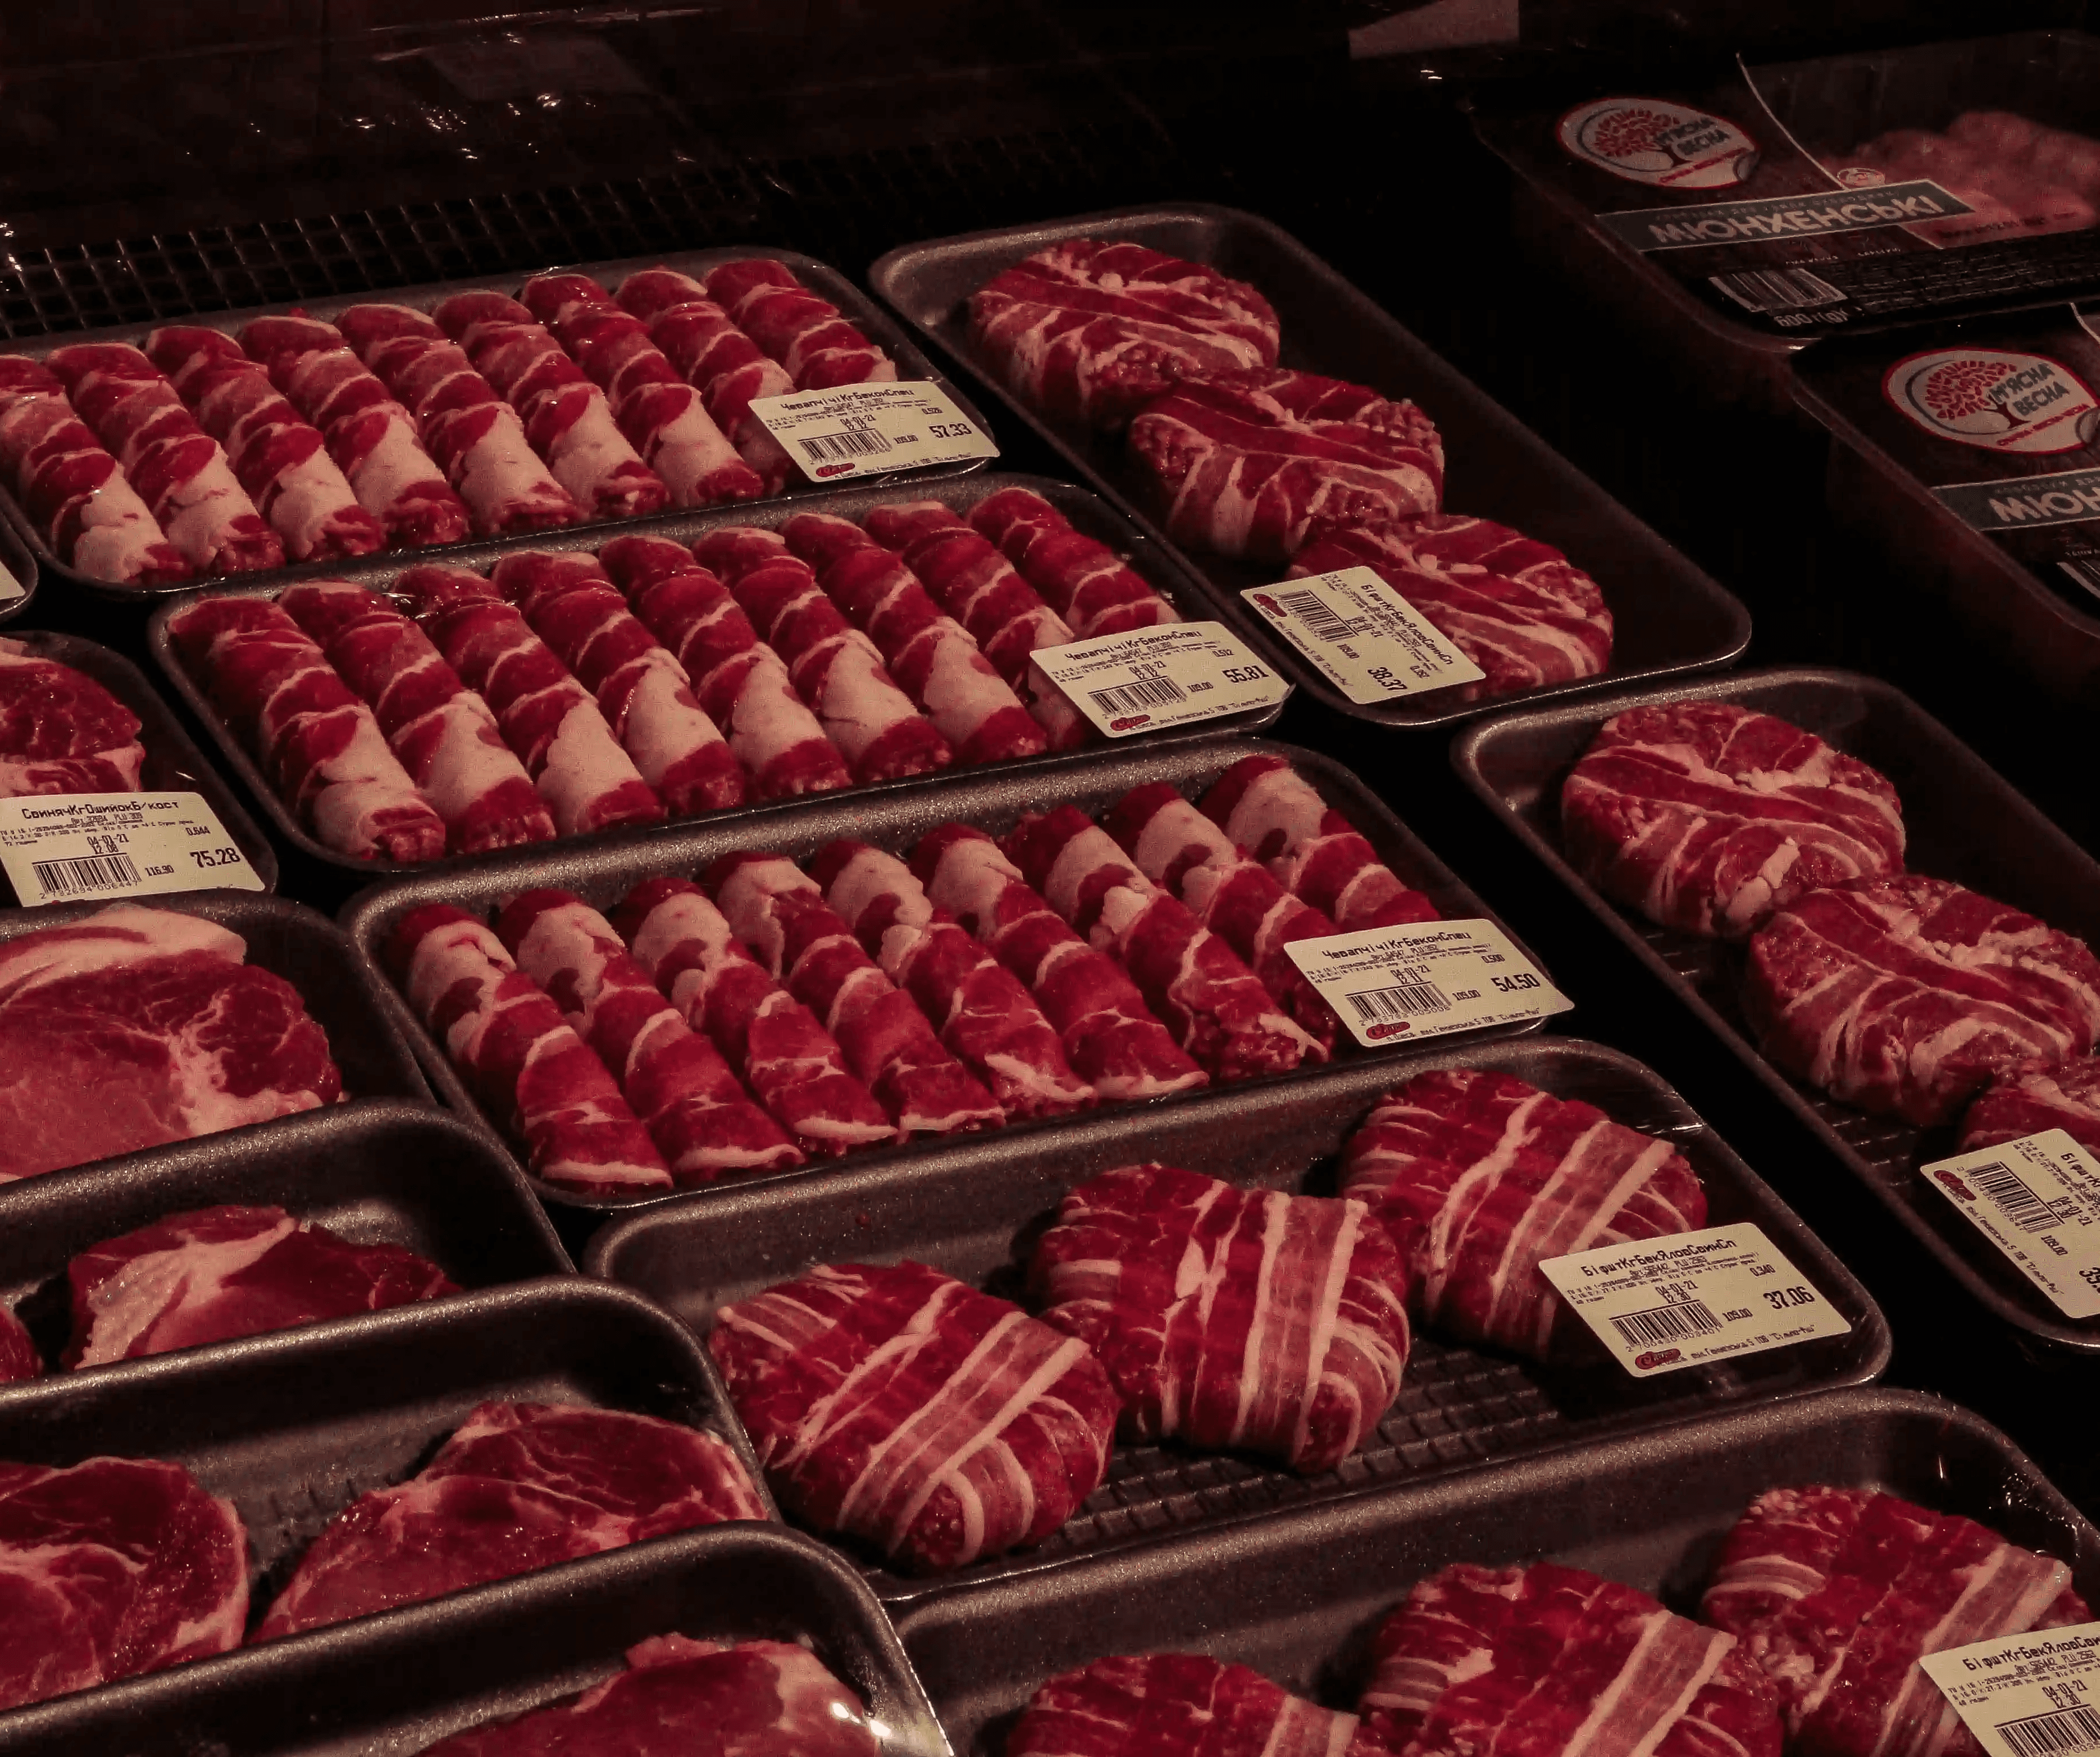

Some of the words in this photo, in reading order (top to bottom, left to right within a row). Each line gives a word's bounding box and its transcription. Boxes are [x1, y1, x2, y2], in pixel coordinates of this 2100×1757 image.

[1648, 194, 1945, 243] МЮНХЕНСЬКІ
[2013, 381, 2070, 416] ВЕСНА
[929, 423, 972, 439] 57.33
[1221, 665, 1269, 683] 55.81
[1367, 667, 1408, 690] 38.37
[190, 847, 241, 868] 75.28
[1490, 973, 1541, 992] 54.50
[1763, 1286, 1815, 1310] 37.06
